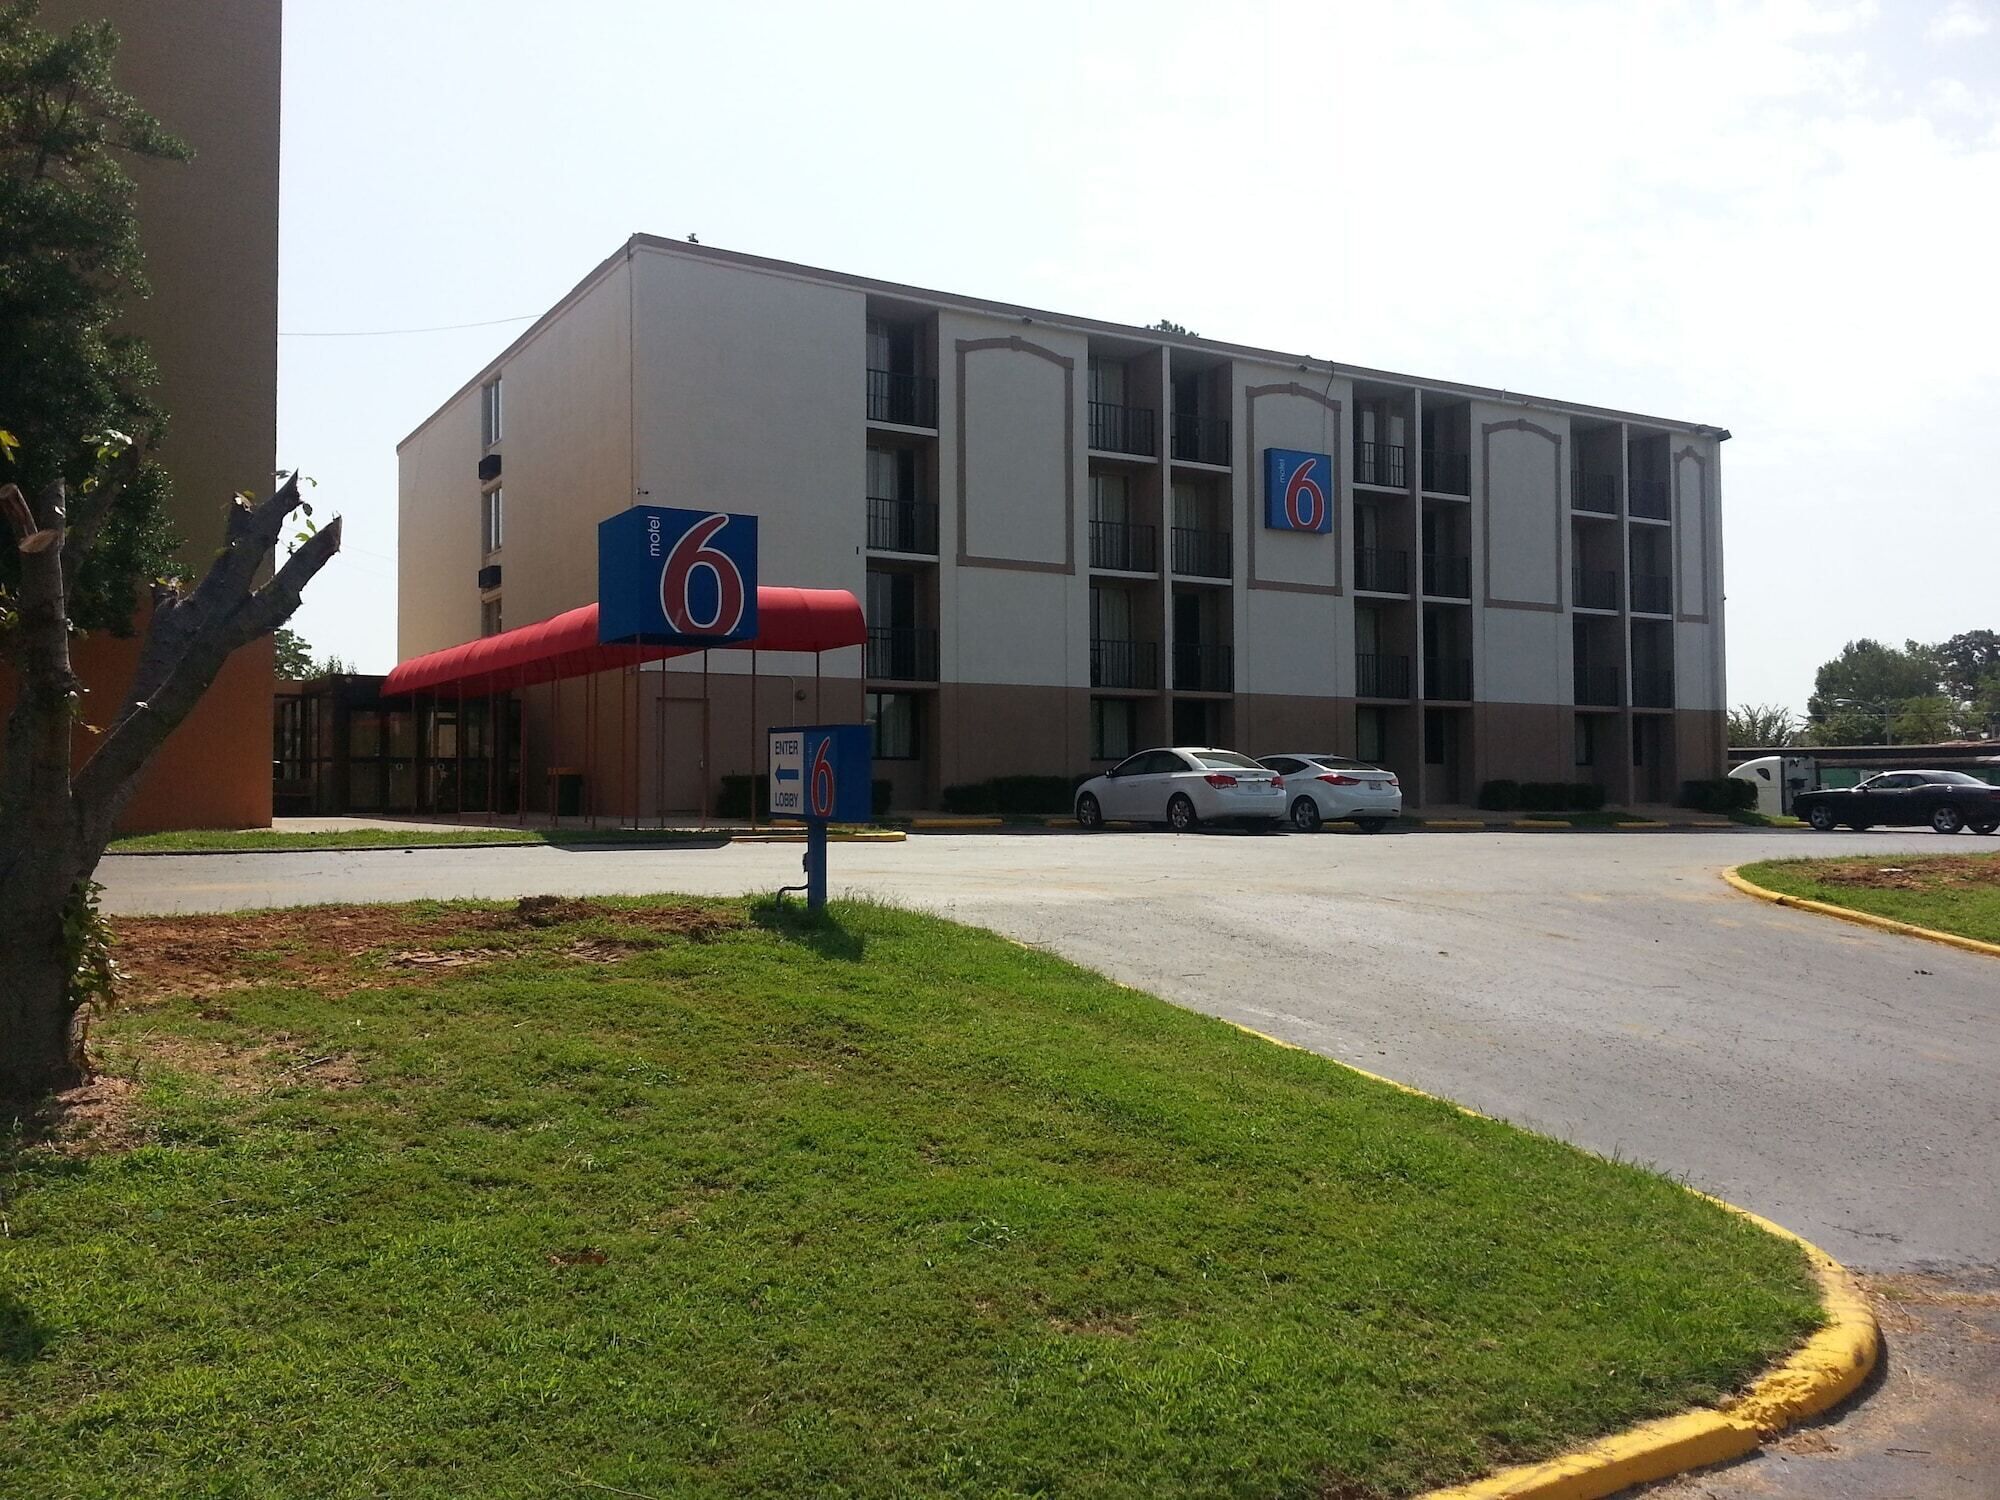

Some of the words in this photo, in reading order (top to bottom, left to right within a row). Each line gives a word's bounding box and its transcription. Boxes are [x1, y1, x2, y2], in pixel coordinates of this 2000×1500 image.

[1284, 458, 1325, 530] 6
[647, 515, 661, 557] motel
[660, 513, 745, 636] 6
[775, 740, 799, 755] ENTER
[811, 735, 835, 817] 6
[774, 792, 799, 808] LOBBY
